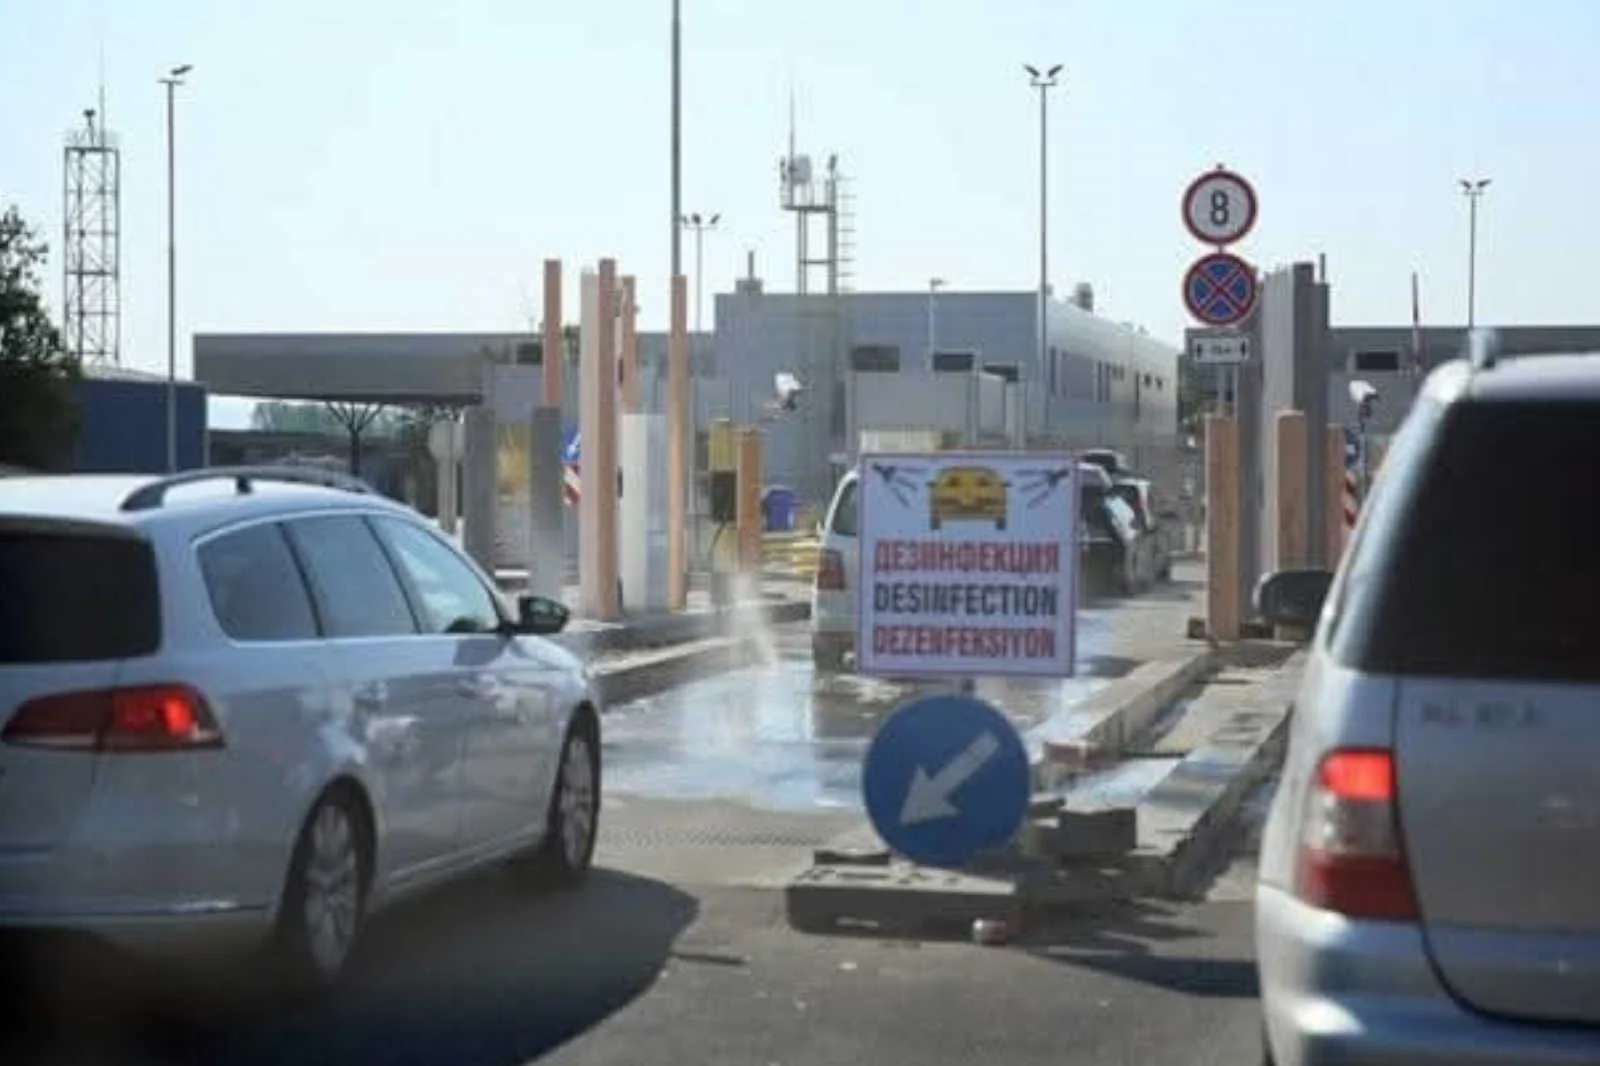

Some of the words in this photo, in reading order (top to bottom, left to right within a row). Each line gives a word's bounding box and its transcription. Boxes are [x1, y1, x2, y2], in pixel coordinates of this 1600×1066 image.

[1210, 190, 1229, 226] 8
[874, 540, 1060, 573] ДЕЗИНФЕКЦИЯ
[874, 582, 1058, 616] DESINFECTION
